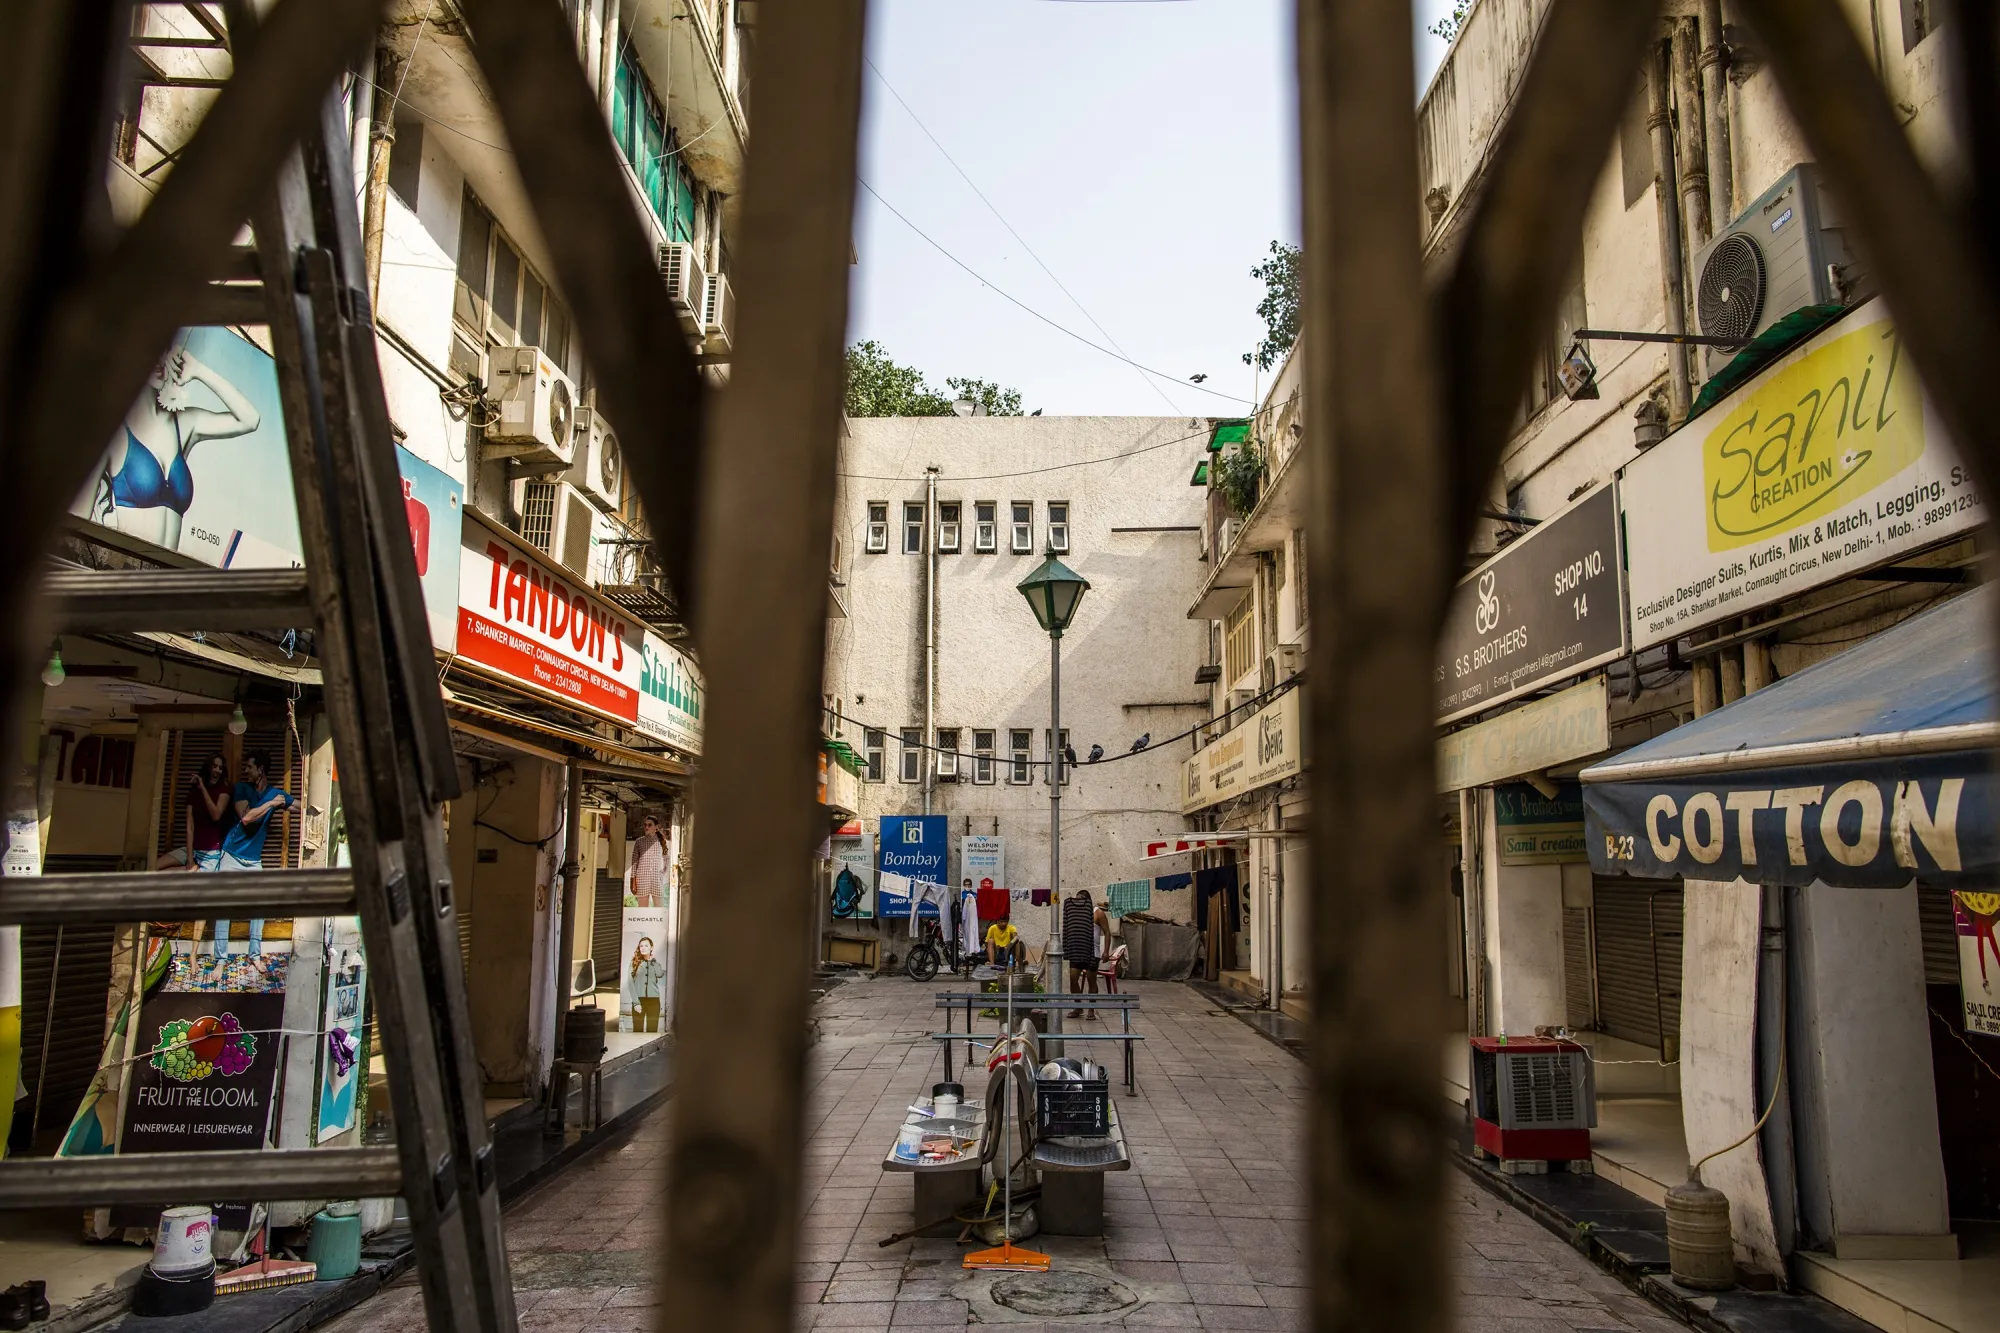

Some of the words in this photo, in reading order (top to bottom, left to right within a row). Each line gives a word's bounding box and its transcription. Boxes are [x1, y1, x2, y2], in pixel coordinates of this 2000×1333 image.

[1712, 327, 1899, 498] Sanil
[1750, 457, 1832, 514] CREATION
[196, 528, 221, 546] CD-050
[1637, 594, 1675, 620] Exclusive
[1676, 574, 1716, 603] Designer
[1718, 562, 1747, 584] Suits,
[1749, 545, 1786, 571] Kurtis,
[1789, 533, 1810, 555] Mix
[1813, 525, 1823, 544] &
[1827, 508, 1873, 541] Match,
[1876, 480, 1946, 520] Legging,
[1555, 560, 1582, 597] SHOP
[1585, 549, 1605, 581] NO.
[1649, 619, 1665, 633] Shop
[1666, 615, 1676, 626] No.
[1691, 598, 1717, 616] Shankar
[1718, 586, 1744, 605] Market,
[1745, 566, 1788, 593] Connaught
[1789, 556, 1820, 577] Circus,
[1822, 548, 1842, 565] New
[1844, 535, 1874, 557] Delhi-
[1875, 531, 1885, 545] 1,
[1888, 521, 1915, 541] Mob.
[486, 540, 625, 673] TANDON'S
[1573, 593, 1588, 621] 14
[467, 617, 474, 633] 7,
[475, 620, 508, 645] SHANKER
[509, 635, 536, 659] MARKET,
[536, 648, 570, 673] CONNAUGHT
[570, 663, 590, 683] CIRCUS,
[590, 674, 601, 687] NEW
[1455, 653, 1472, 678] S.S.
[1473, 625, 1528, 670] BROTHERS
[534, 664, 551, 682] Phone
[641, 643, 699, 720] Stylish
[1646, 777, 1965, 872] COTTON
[884, 850, 942, 868] Bombay
[1507, 837, 1536, 853] Sanil
[1605, 835, 1634, 860] B-23
[1966, 1001, 1987, 1018] SANIL
[137, 1086, 188, 1106] FRUIT
[186, 1096, 201, 1107] THE
[189, 1087, 201, 1097] OF
[133, 1123, 186, 1133] INNERWEAR
[193, 1124, 253, 1134] LEISUREWEAR
